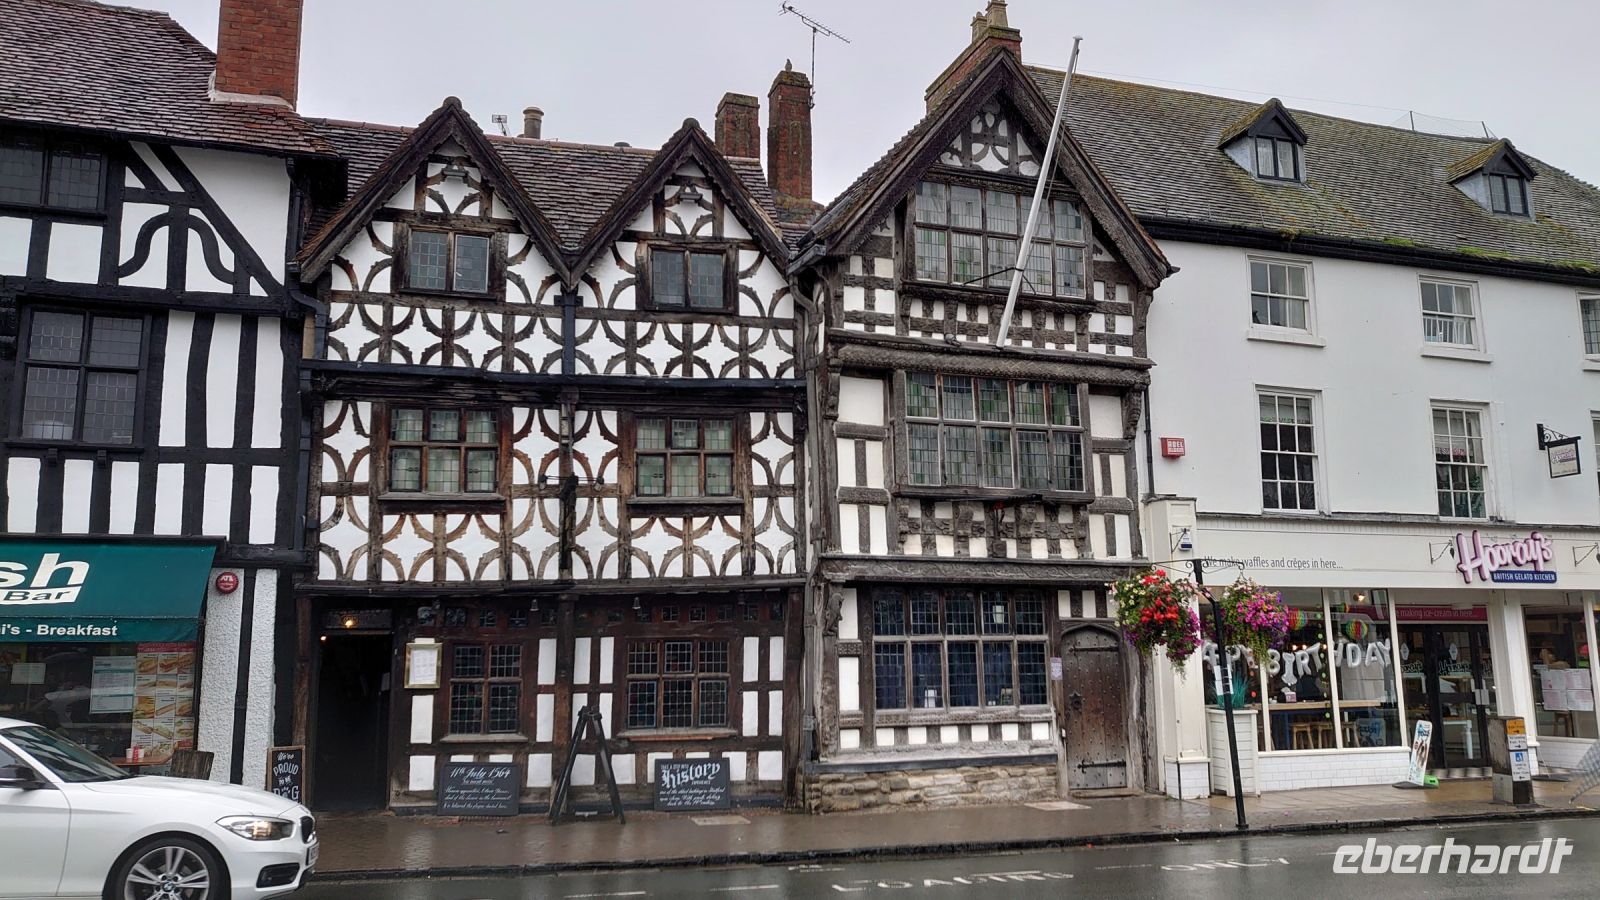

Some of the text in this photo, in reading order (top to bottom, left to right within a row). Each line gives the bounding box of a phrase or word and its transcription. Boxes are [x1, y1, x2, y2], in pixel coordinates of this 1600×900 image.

[1242, 556, 1270, 568] waffles
[1271, 557, 1285, 568] and
[1311, 558, 1318, 568] in
[1320, 558, 1344, 569] here...
[1456, 530, 1552, 583] Hooray's
[1493, 571, 1555, 581] BRITISH GELATO KITCHEN
[3, 590, 71, 600] Bar
[0, 623, 20, 635] i's
[37, 624, 118, 636] Breakfast
[273, 762, 299, 776] PROUD
[464, 767, 487, 780] July
[488, 767, 511, 778] 1564
[661, 762, 721, 789] history
